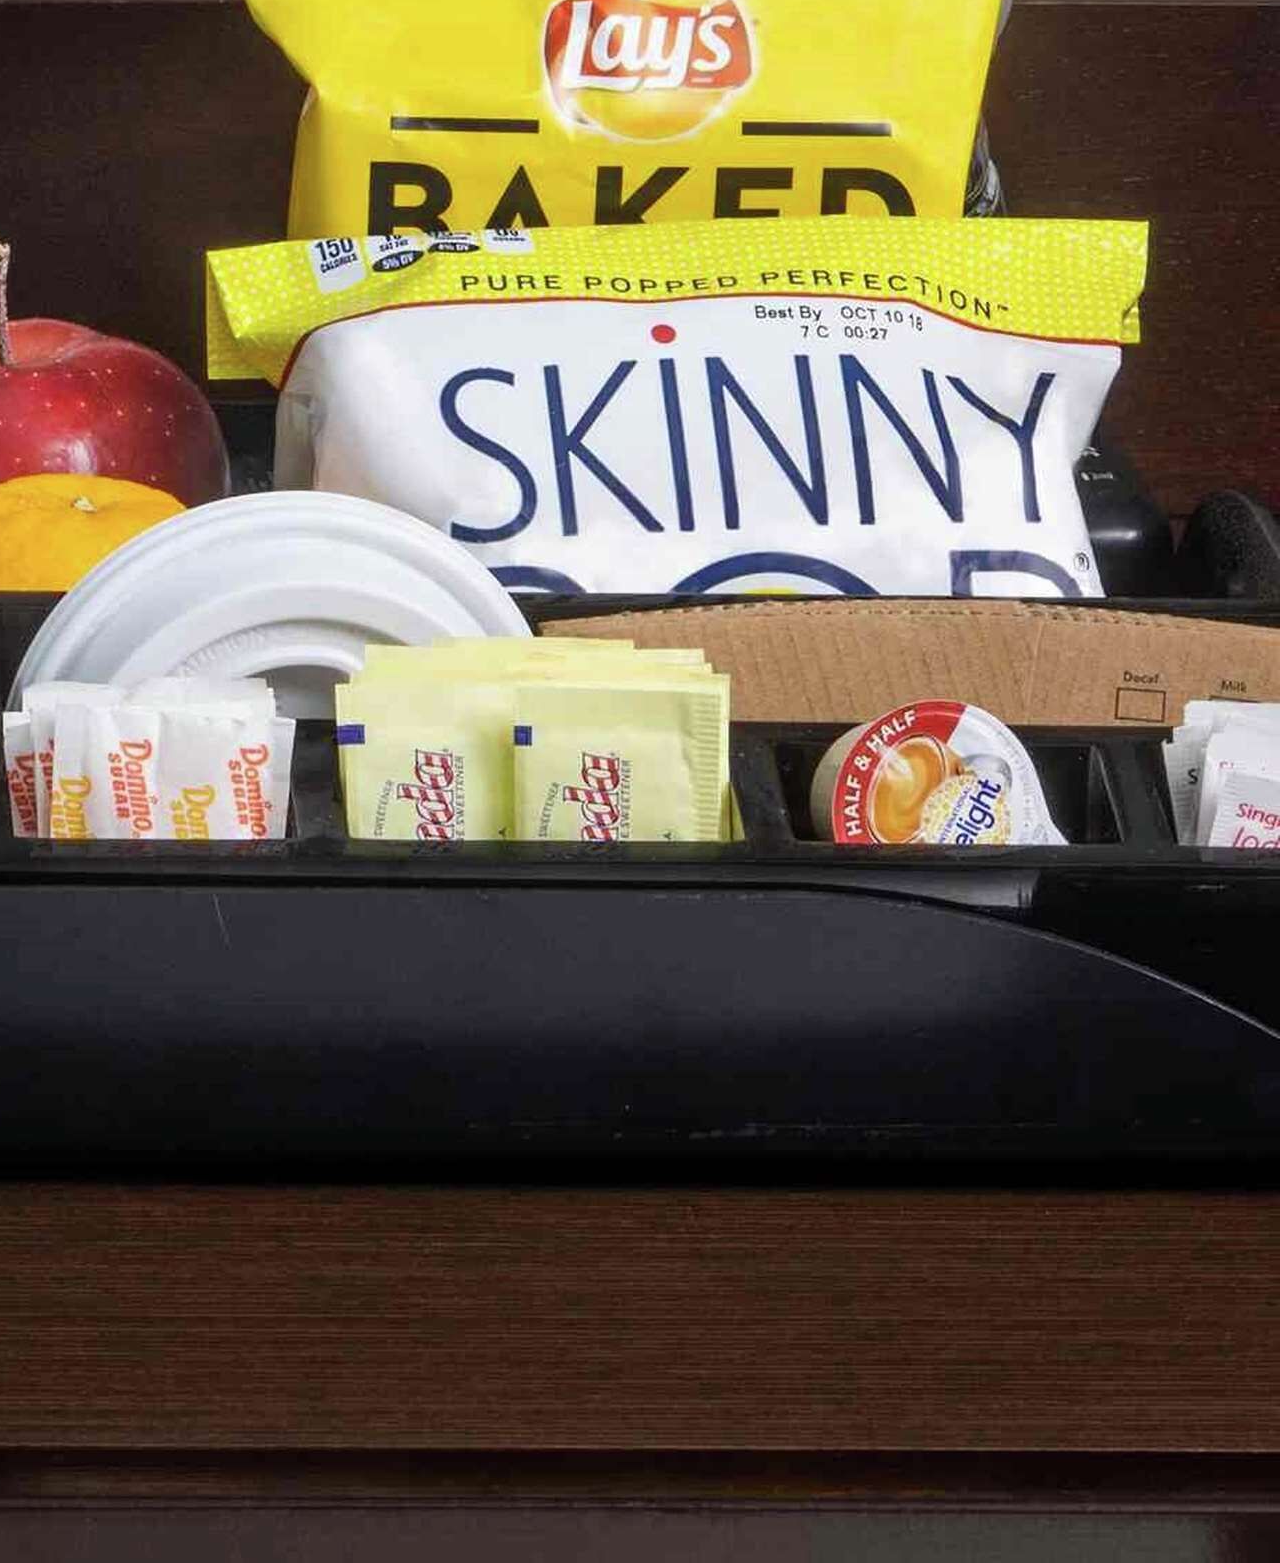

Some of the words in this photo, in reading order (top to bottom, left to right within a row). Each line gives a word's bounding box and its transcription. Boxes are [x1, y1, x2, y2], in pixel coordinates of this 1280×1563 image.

[560, 0, 737, 90] Lay's
[314, 238, 355, 261] 150
[460, 274, 563, 292] PURE
[584, 274, 739, 294] POPPED
[754, 305, 794, 320] Best
[800, 306, 823, 323] By
[840, 305, 878, 323] OCT
[885, 307, 905, 324] 10
[800, 324, 812, 339] 7
[817, 325, 830, 340] C
[844, 325, 889, 341] 00:27
[440, 324, 1056, 544] SKINNY
[1122, 670, 1160, 684] Decaf
[1220, 680, 1248, 694] Milk
[107, 752, 131, 820] SUGAR
[119, 739, 153, 833] Domino
[228, 759, 249, 826] SUGAR
[240, 743, 271, 838] Domino
[843, 773, 862, 837] HALF
[853, 754, 872, 772] &
[865, 709, 918, 754] HALF
[58, 775, 93, 838] Dom
[181, 784, 217, 838] Dom
[954, 777, 1002, 845] elight
[1235, 802, 1280, 830] Sing
